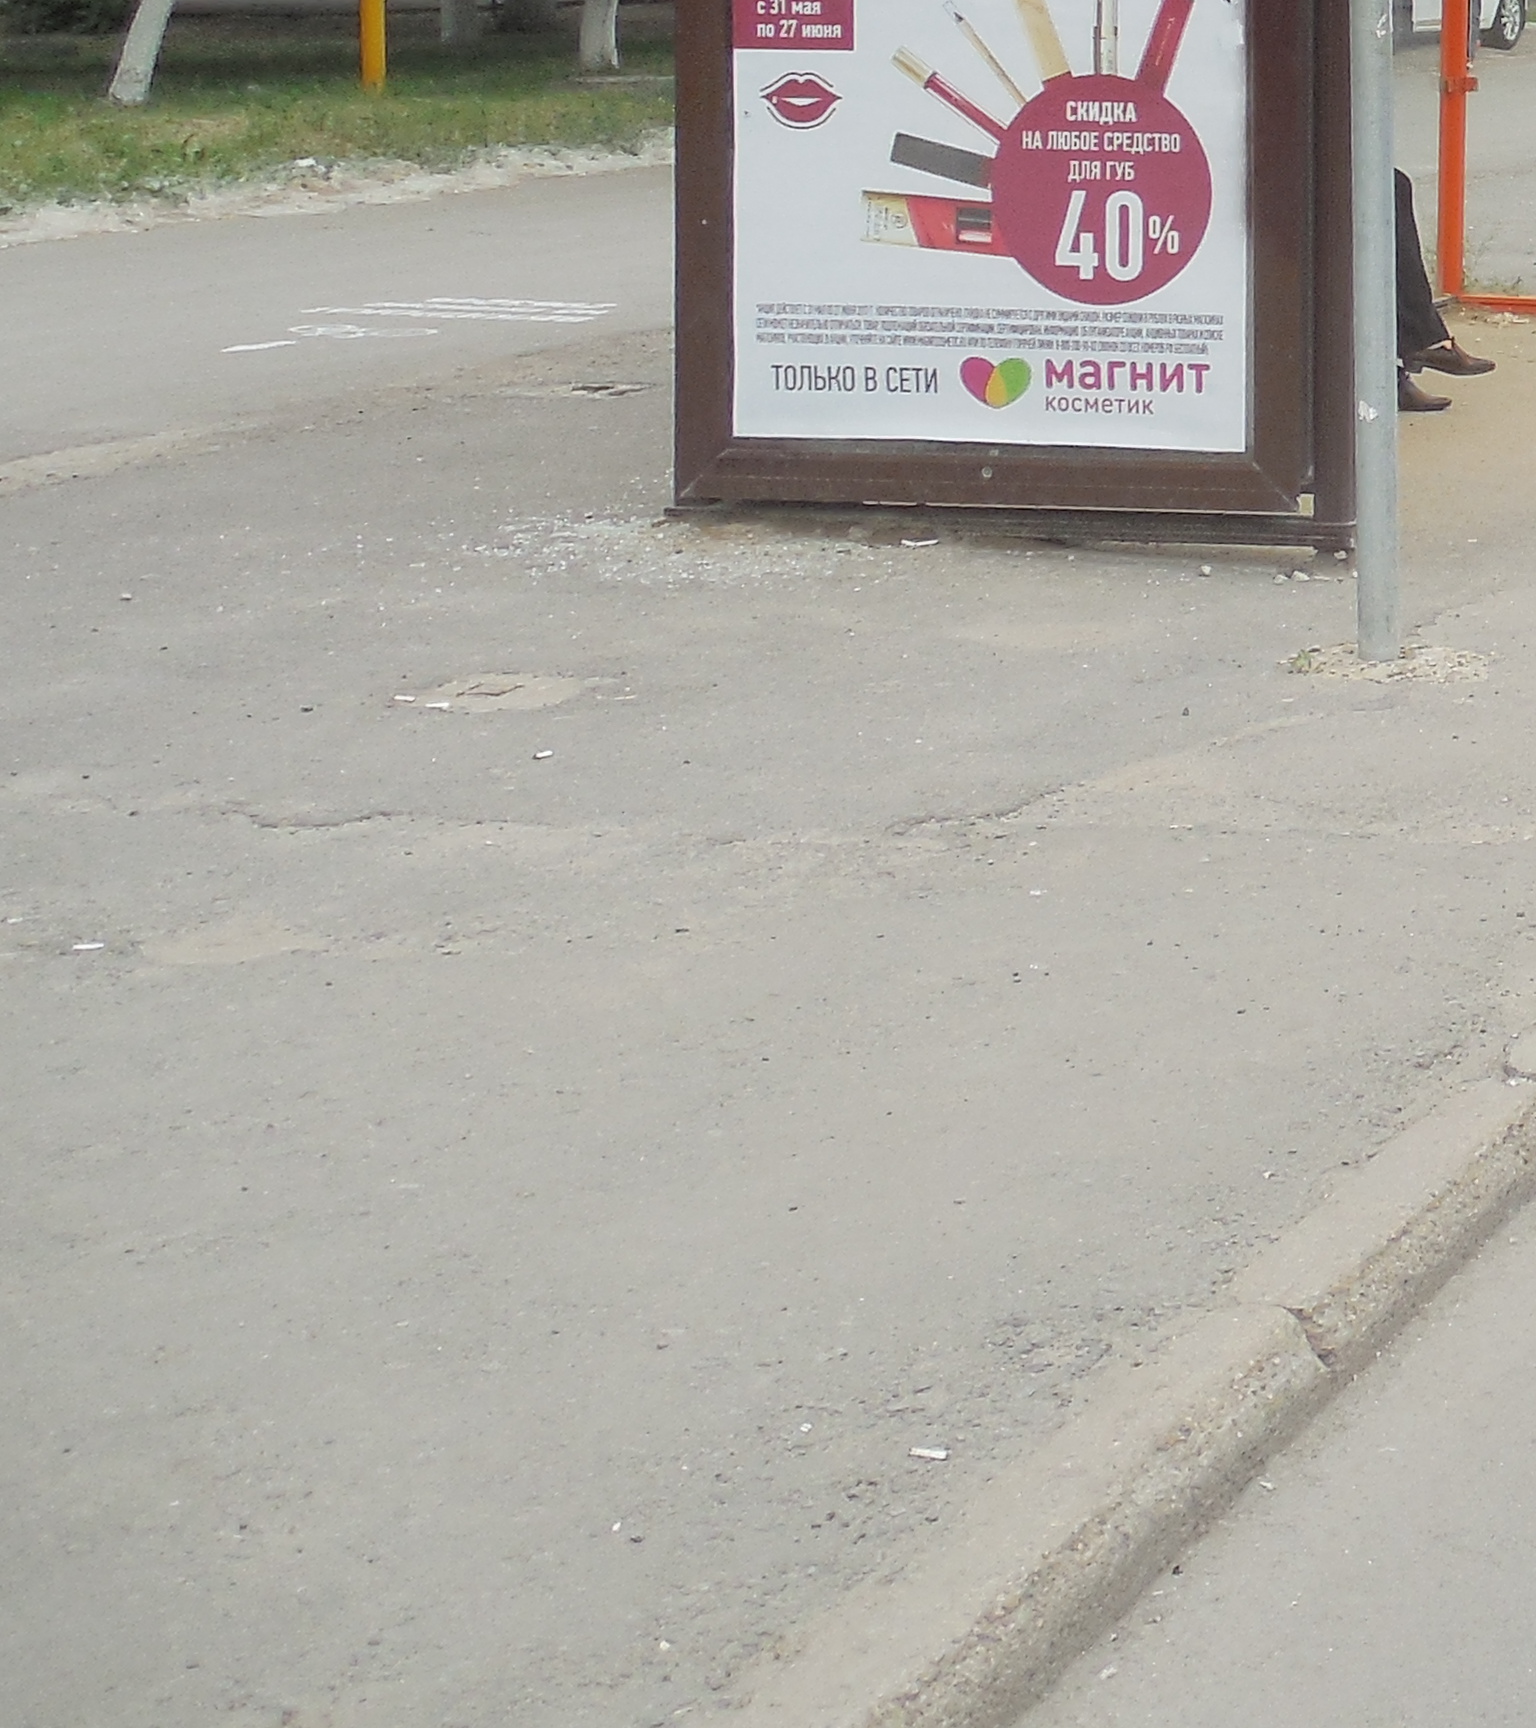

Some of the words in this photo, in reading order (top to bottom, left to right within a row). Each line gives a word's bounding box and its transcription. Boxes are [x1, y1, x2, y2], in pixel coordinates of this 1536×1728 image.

[756, 0, 766, 15] с
[791, 1, 821, 15] мая
[756, 23, 775, 38] по
[779, 19, 798, 38] 27
[802, 24, 842, 38] июня
[1065, 101, 1137, 125] СКИДКА
[1022, 131, 1042, 150] НА
[1047, 132, 1099, 151] ЛЮБОЕ
[1103, 133, 1181, 155] СРЕДСТВО
[1067, 160, 1100, 182] ДЛЯ
[1105, 161, 1135, 181] ГУБ
[770, 364, 856, 393] ТОЛЬКО
[865, 366, 878, 392] В
[886, 367, 939, 394] СЕТИ
[1044, 358, 1211, 394] магнит
[1044, 396, 1155, 416] косметик
